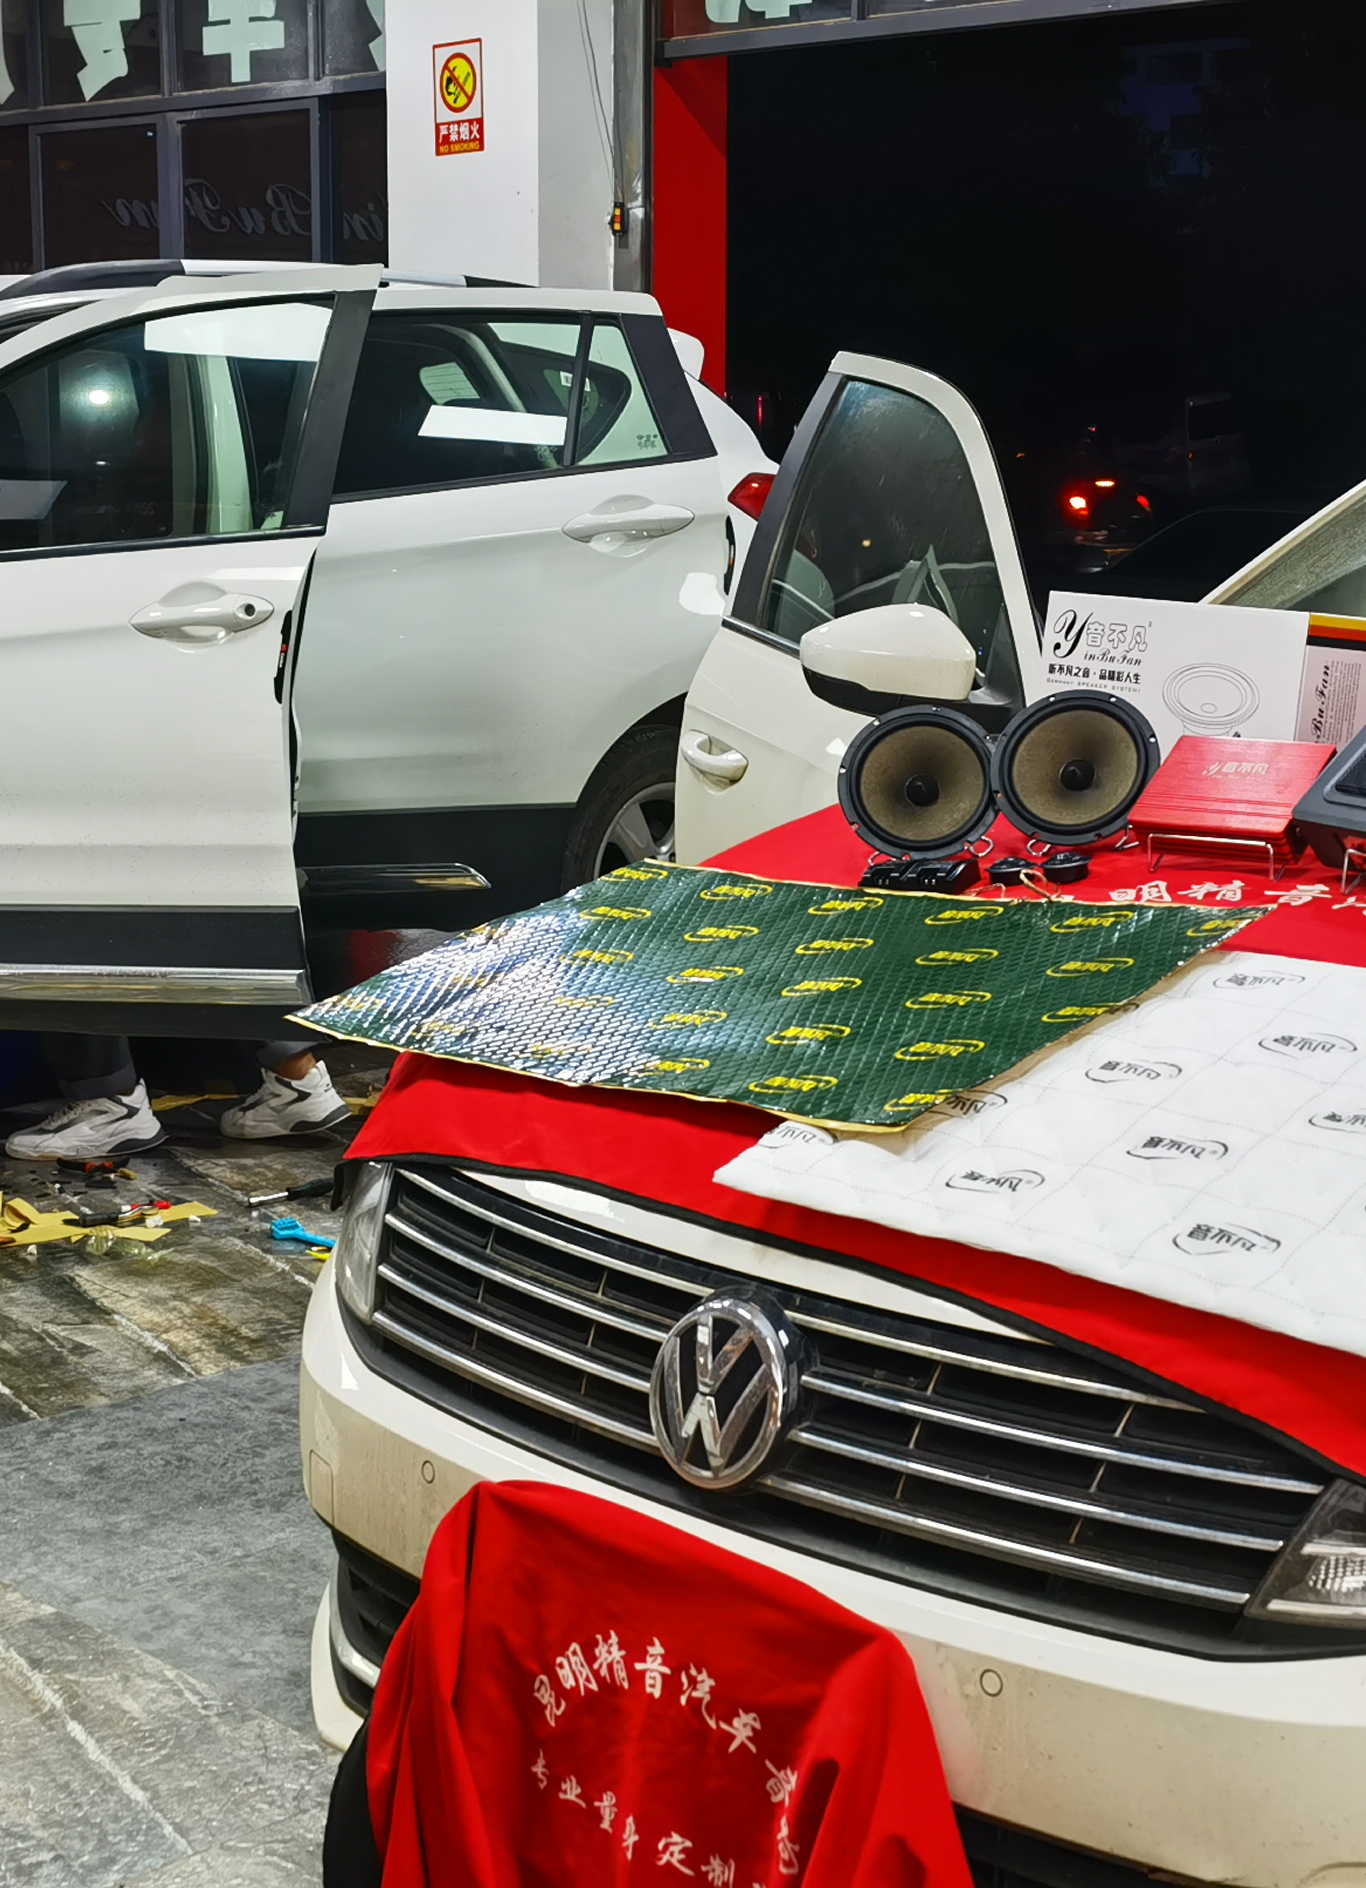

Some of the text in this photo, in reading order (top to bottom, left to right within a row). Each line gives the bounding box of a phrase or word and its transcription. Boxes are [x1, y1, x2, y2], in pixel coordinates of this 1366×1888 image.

[439, 121, 480, 143] 严禁烟火
[439, 141, 480, 153] NO SMOKING
[1086, 620, 1148, 652] 音不凡
[1077, 681, 1108, 689] SPEAKER
[530, 1747, 768, 1888] 专业量身定制
